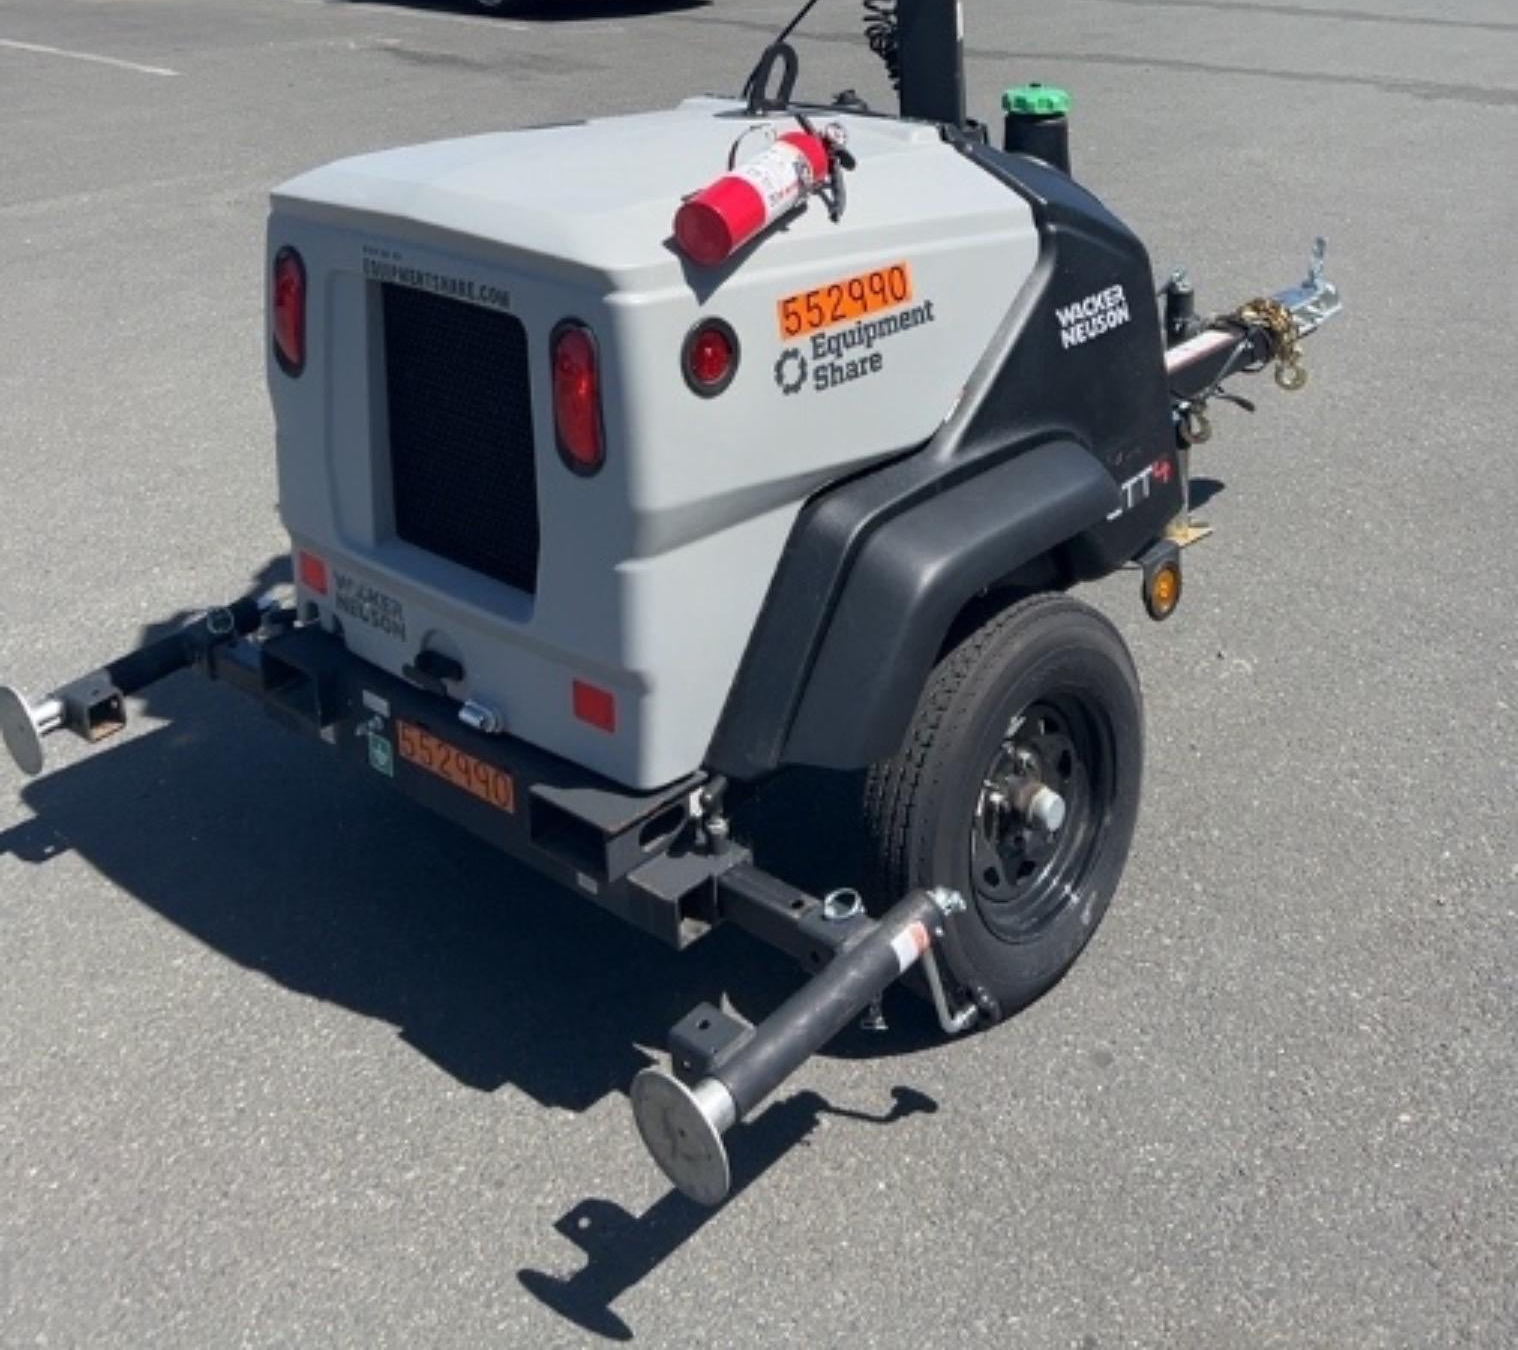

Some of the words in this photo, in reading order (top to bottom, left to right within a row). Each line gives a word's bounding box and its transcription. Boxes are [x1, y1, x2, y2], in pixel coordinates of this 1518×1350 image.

[781, 265, 907, 336] 552990
[1055, 283, 1126, 327] WACKER
[1061, 302, 1130, 349] NEUSON
[811, 299, 935, 360] Equipment
[813, 352, 883, 392] Share
[401, 725, 510, 808] 552990
